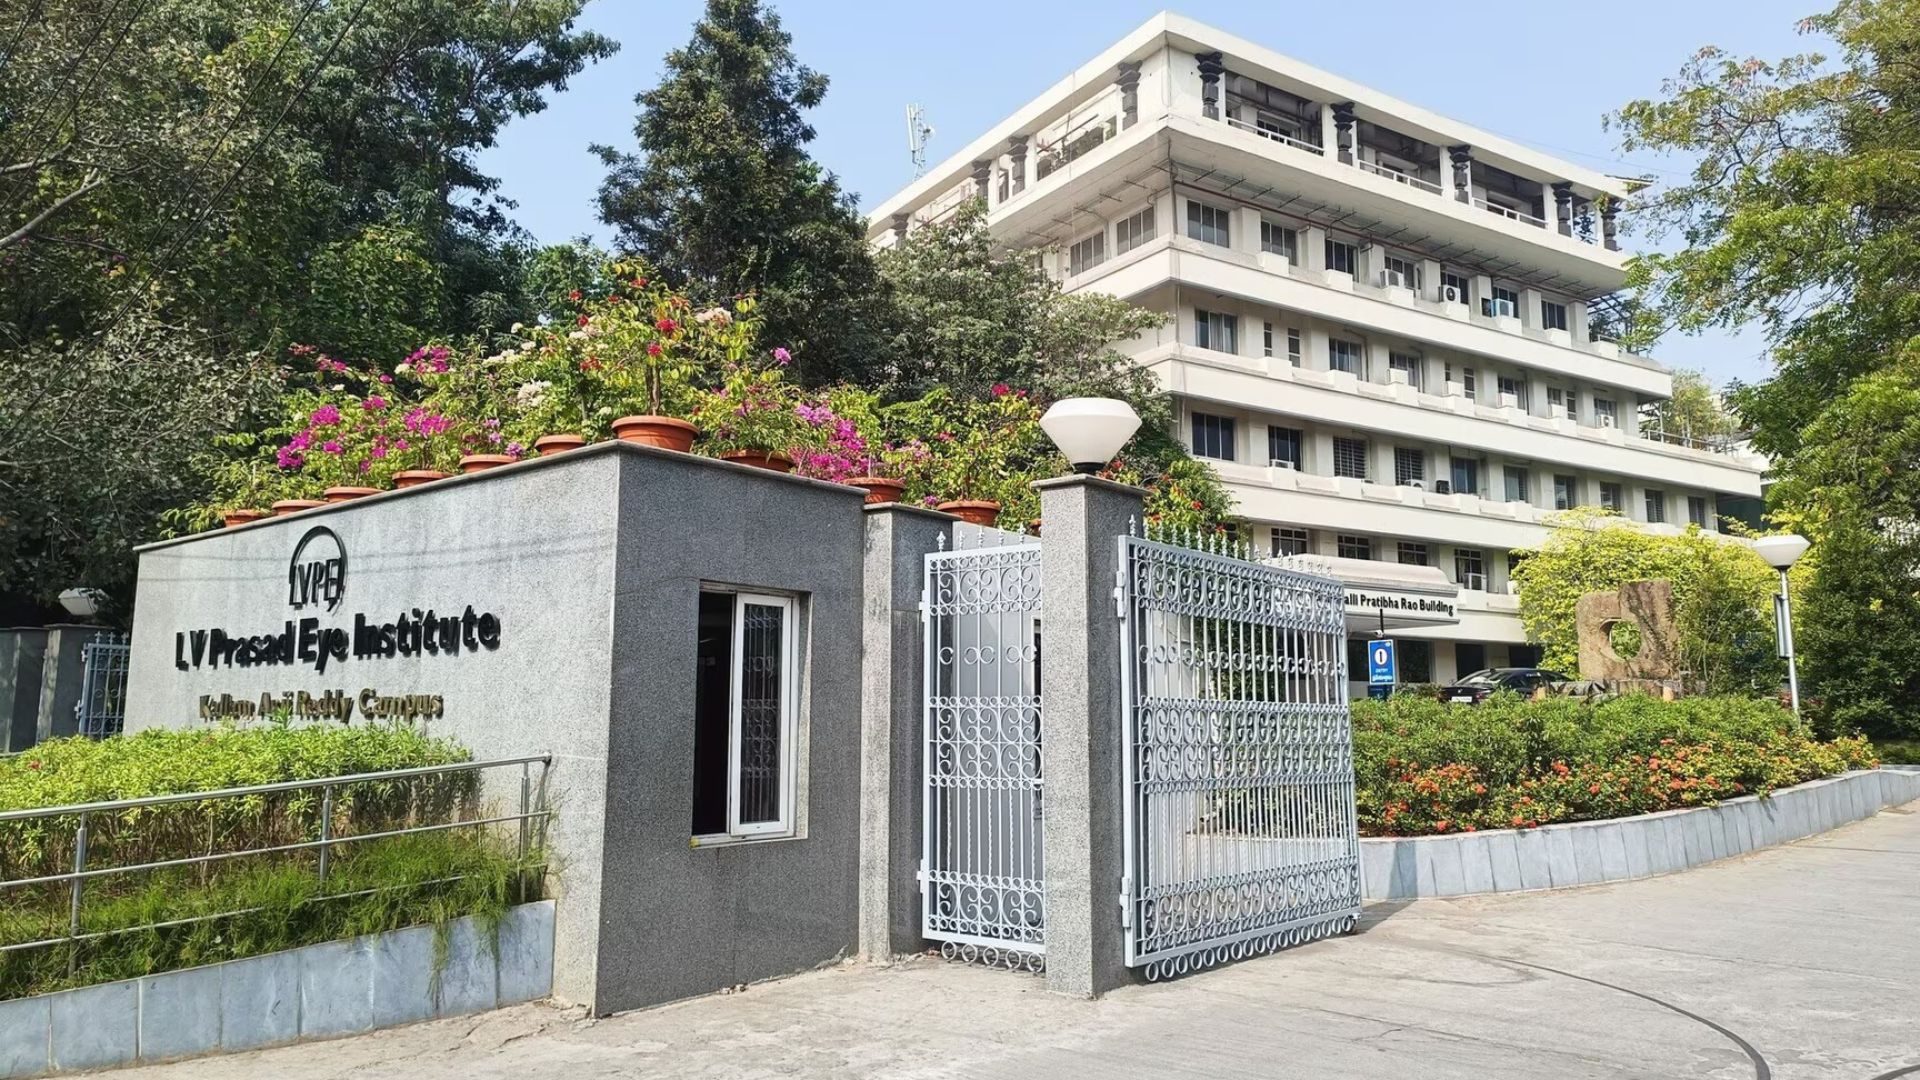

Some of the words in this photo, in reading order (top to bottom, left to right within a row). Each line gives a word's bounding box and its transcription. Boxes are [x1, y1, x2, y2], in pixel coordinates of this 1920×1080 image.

[1360, 594, 1399, 609] Pratibha
[1401, 598, 1418, 610] Rao
[1420, 599, 1454, 617] Building
[175, 631, 189, 672] L
[190, 629, 208, 670] V
[208, 620, 297, 671] Prasad
[298, 617, 349, 676] Eye
[353, 604, 501, 661] Institute
[296, 689, 354, 725] Reddy
[359, 688, 444, 725] Campus
